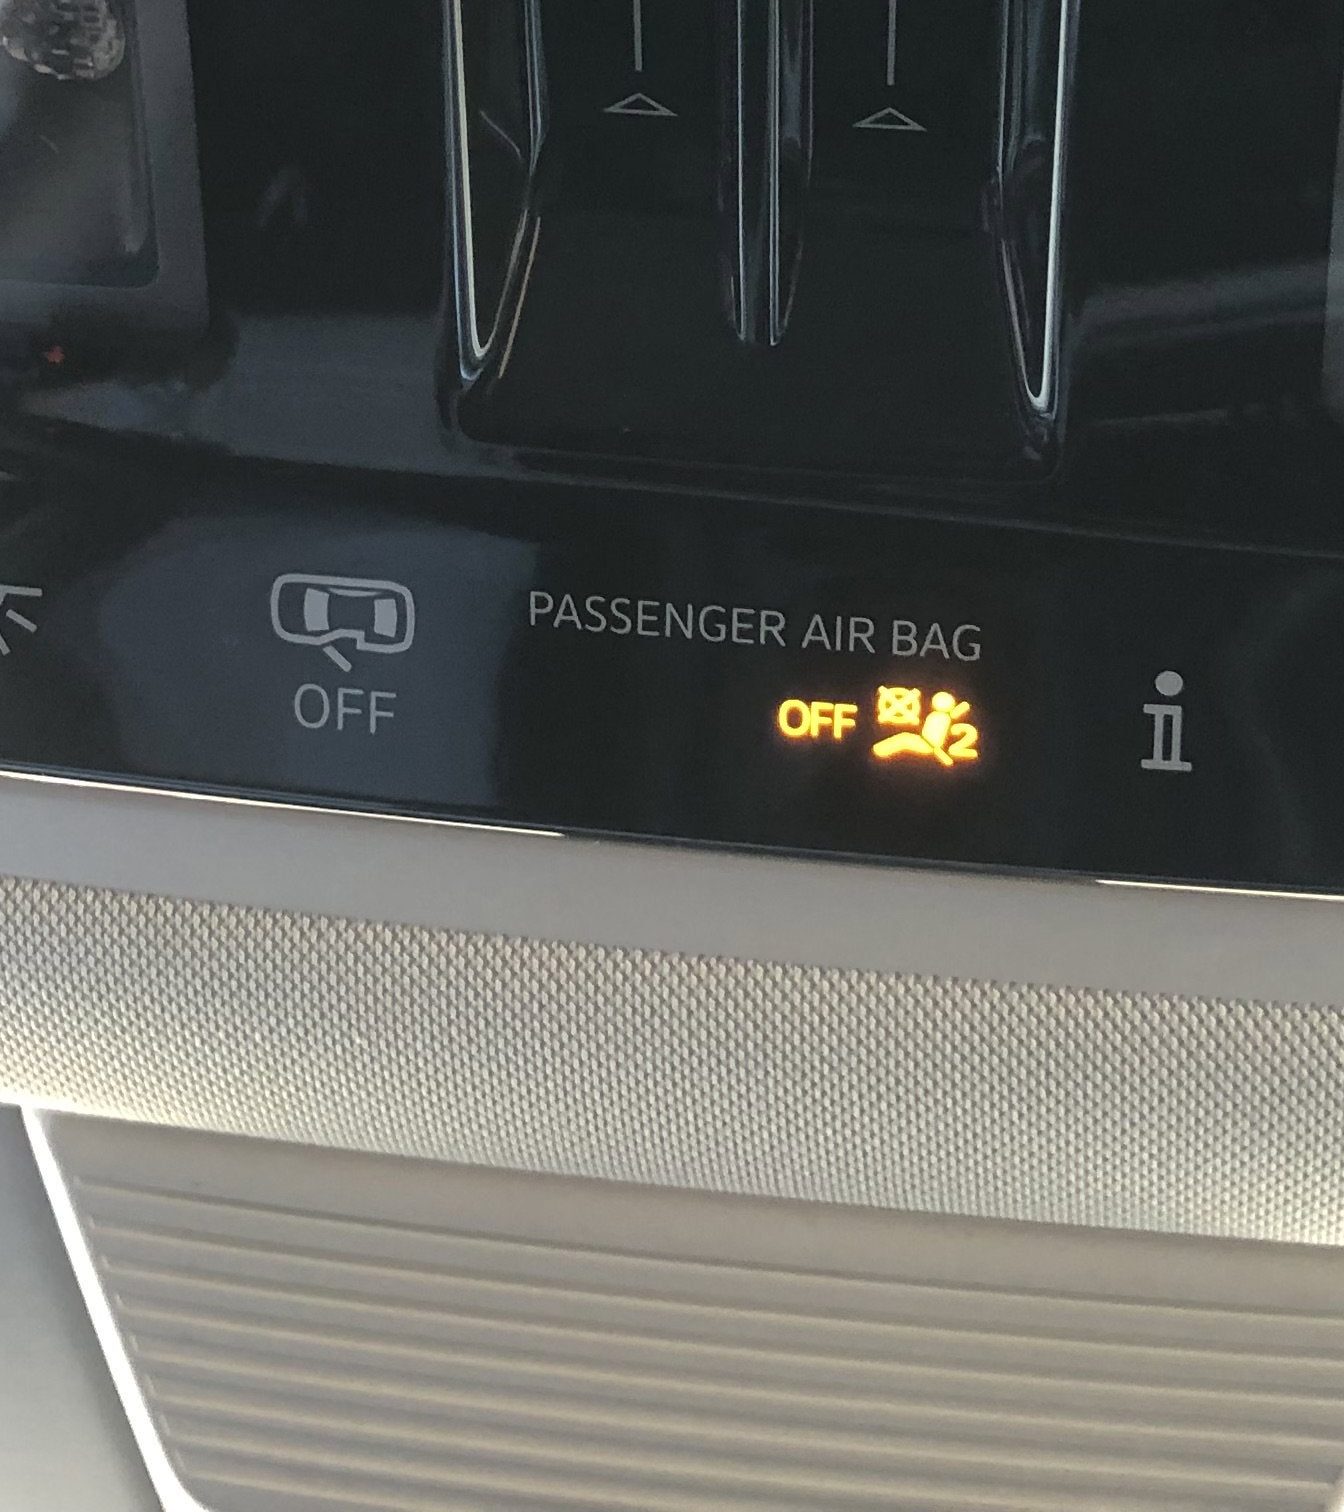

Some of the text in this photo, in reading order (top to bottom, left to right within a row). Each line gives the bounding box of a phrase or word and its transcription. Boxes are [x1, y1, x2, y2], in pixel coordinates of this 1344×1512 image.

[529, 590, 983, 662] PASSENGER AIR BAG
[293, 683, 398, 735] OFF
[777, 698, 858, 740] OFF
